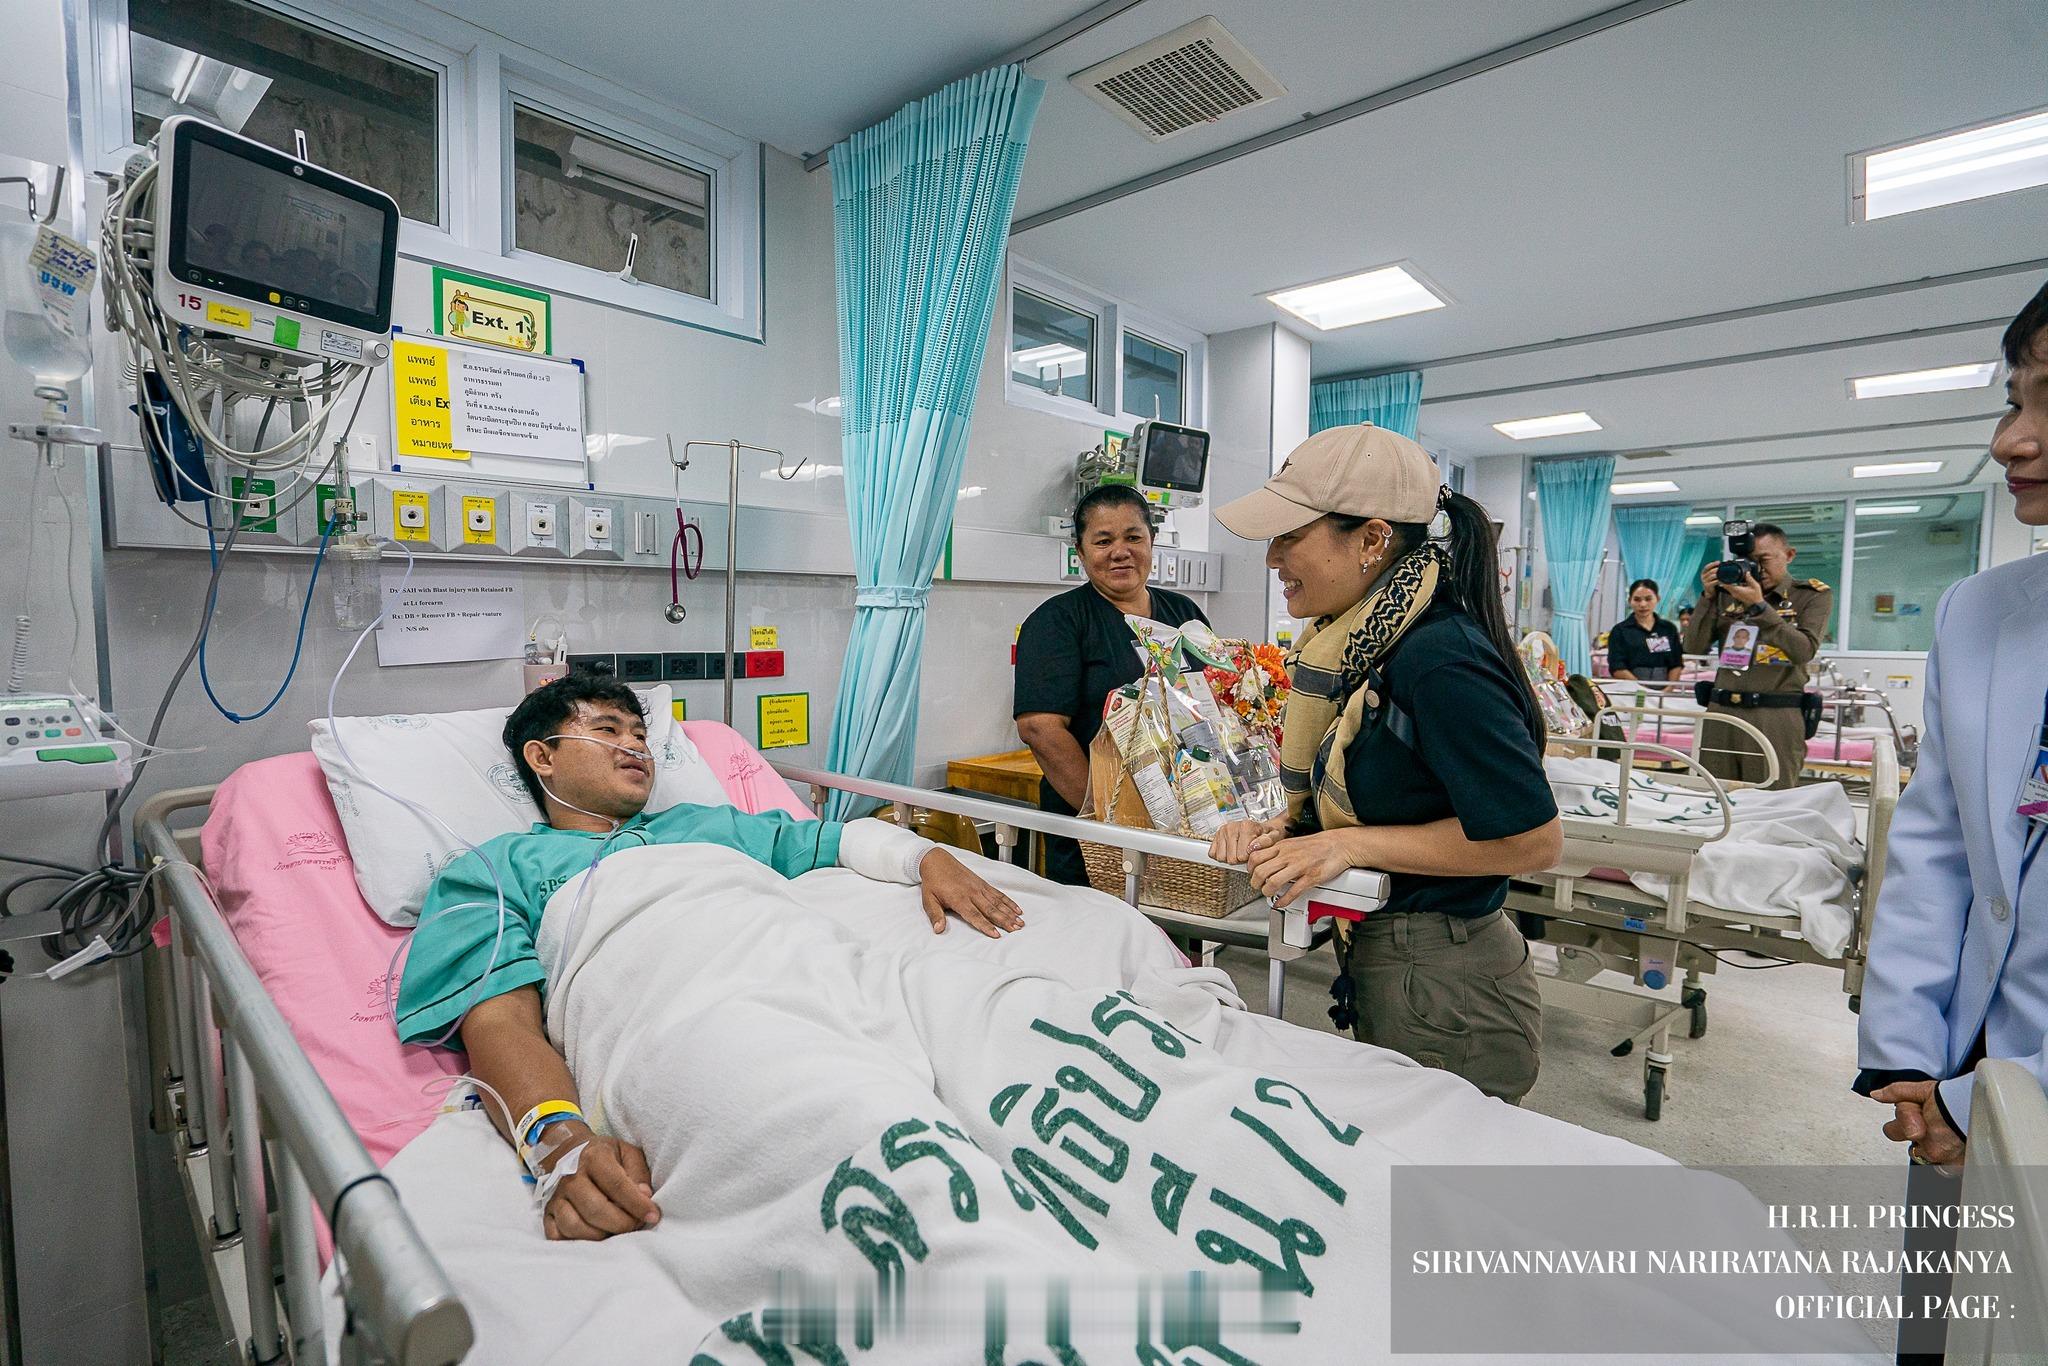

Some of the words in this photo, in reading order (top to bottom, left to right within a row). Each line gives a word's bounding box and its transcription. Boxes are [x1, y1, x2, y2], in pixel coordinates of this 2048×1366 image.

[178, 294, 202, 310] 15
[472, 310, 508, 331] Ext.
[516, 320, 525, 334] 1
[407, 355, 436, 366] แพทย์
[408, 375, 437, 387] แพทย์
[411, 418, 440, 429] อาหาร
[449, 587, 466, 595] injury
